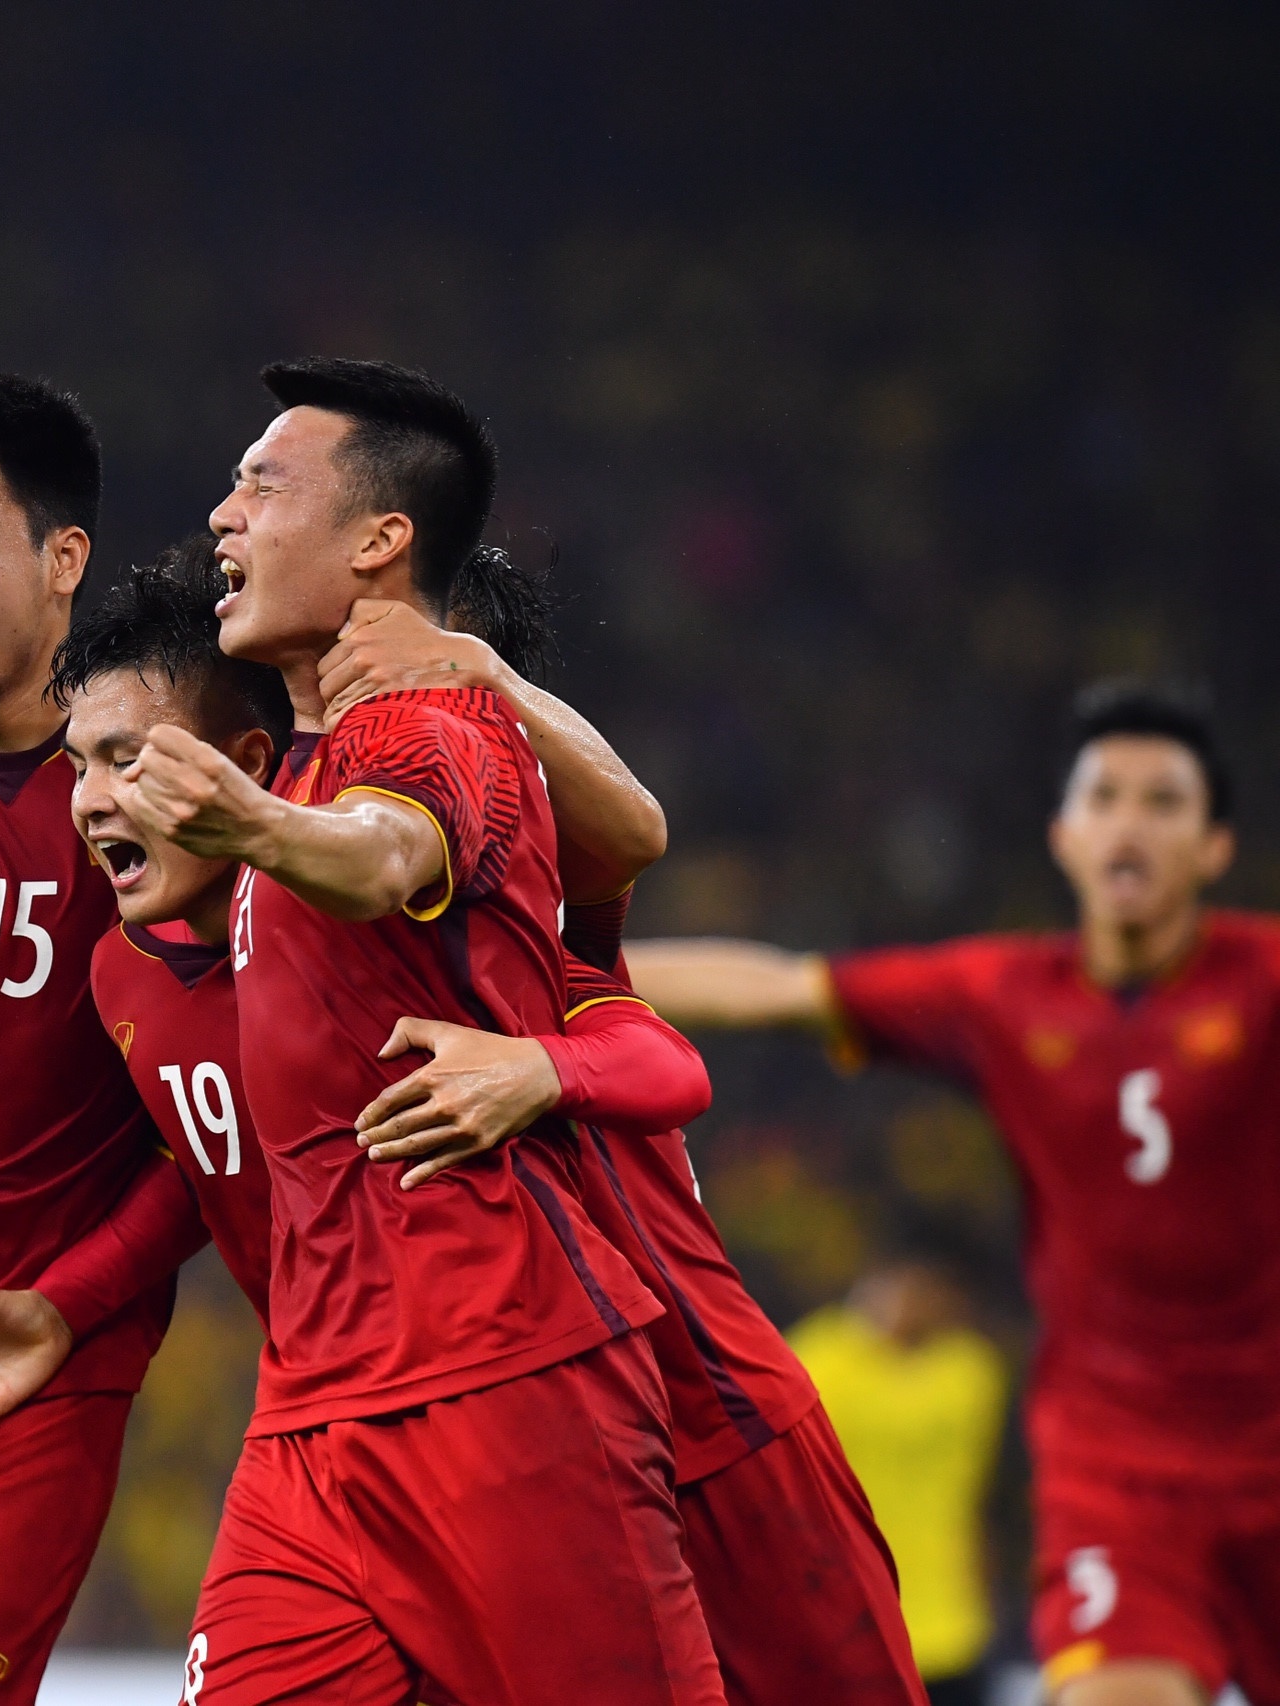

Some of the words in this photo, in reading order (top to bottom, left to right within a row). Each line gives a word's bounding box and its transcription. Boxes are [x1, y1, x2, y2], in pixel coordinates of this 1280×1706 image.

[158, 1061, 241, 1176] 19
[1119, 1069, 1172, 1184] 5
[1066, 1545, 1118, 1634] 5
